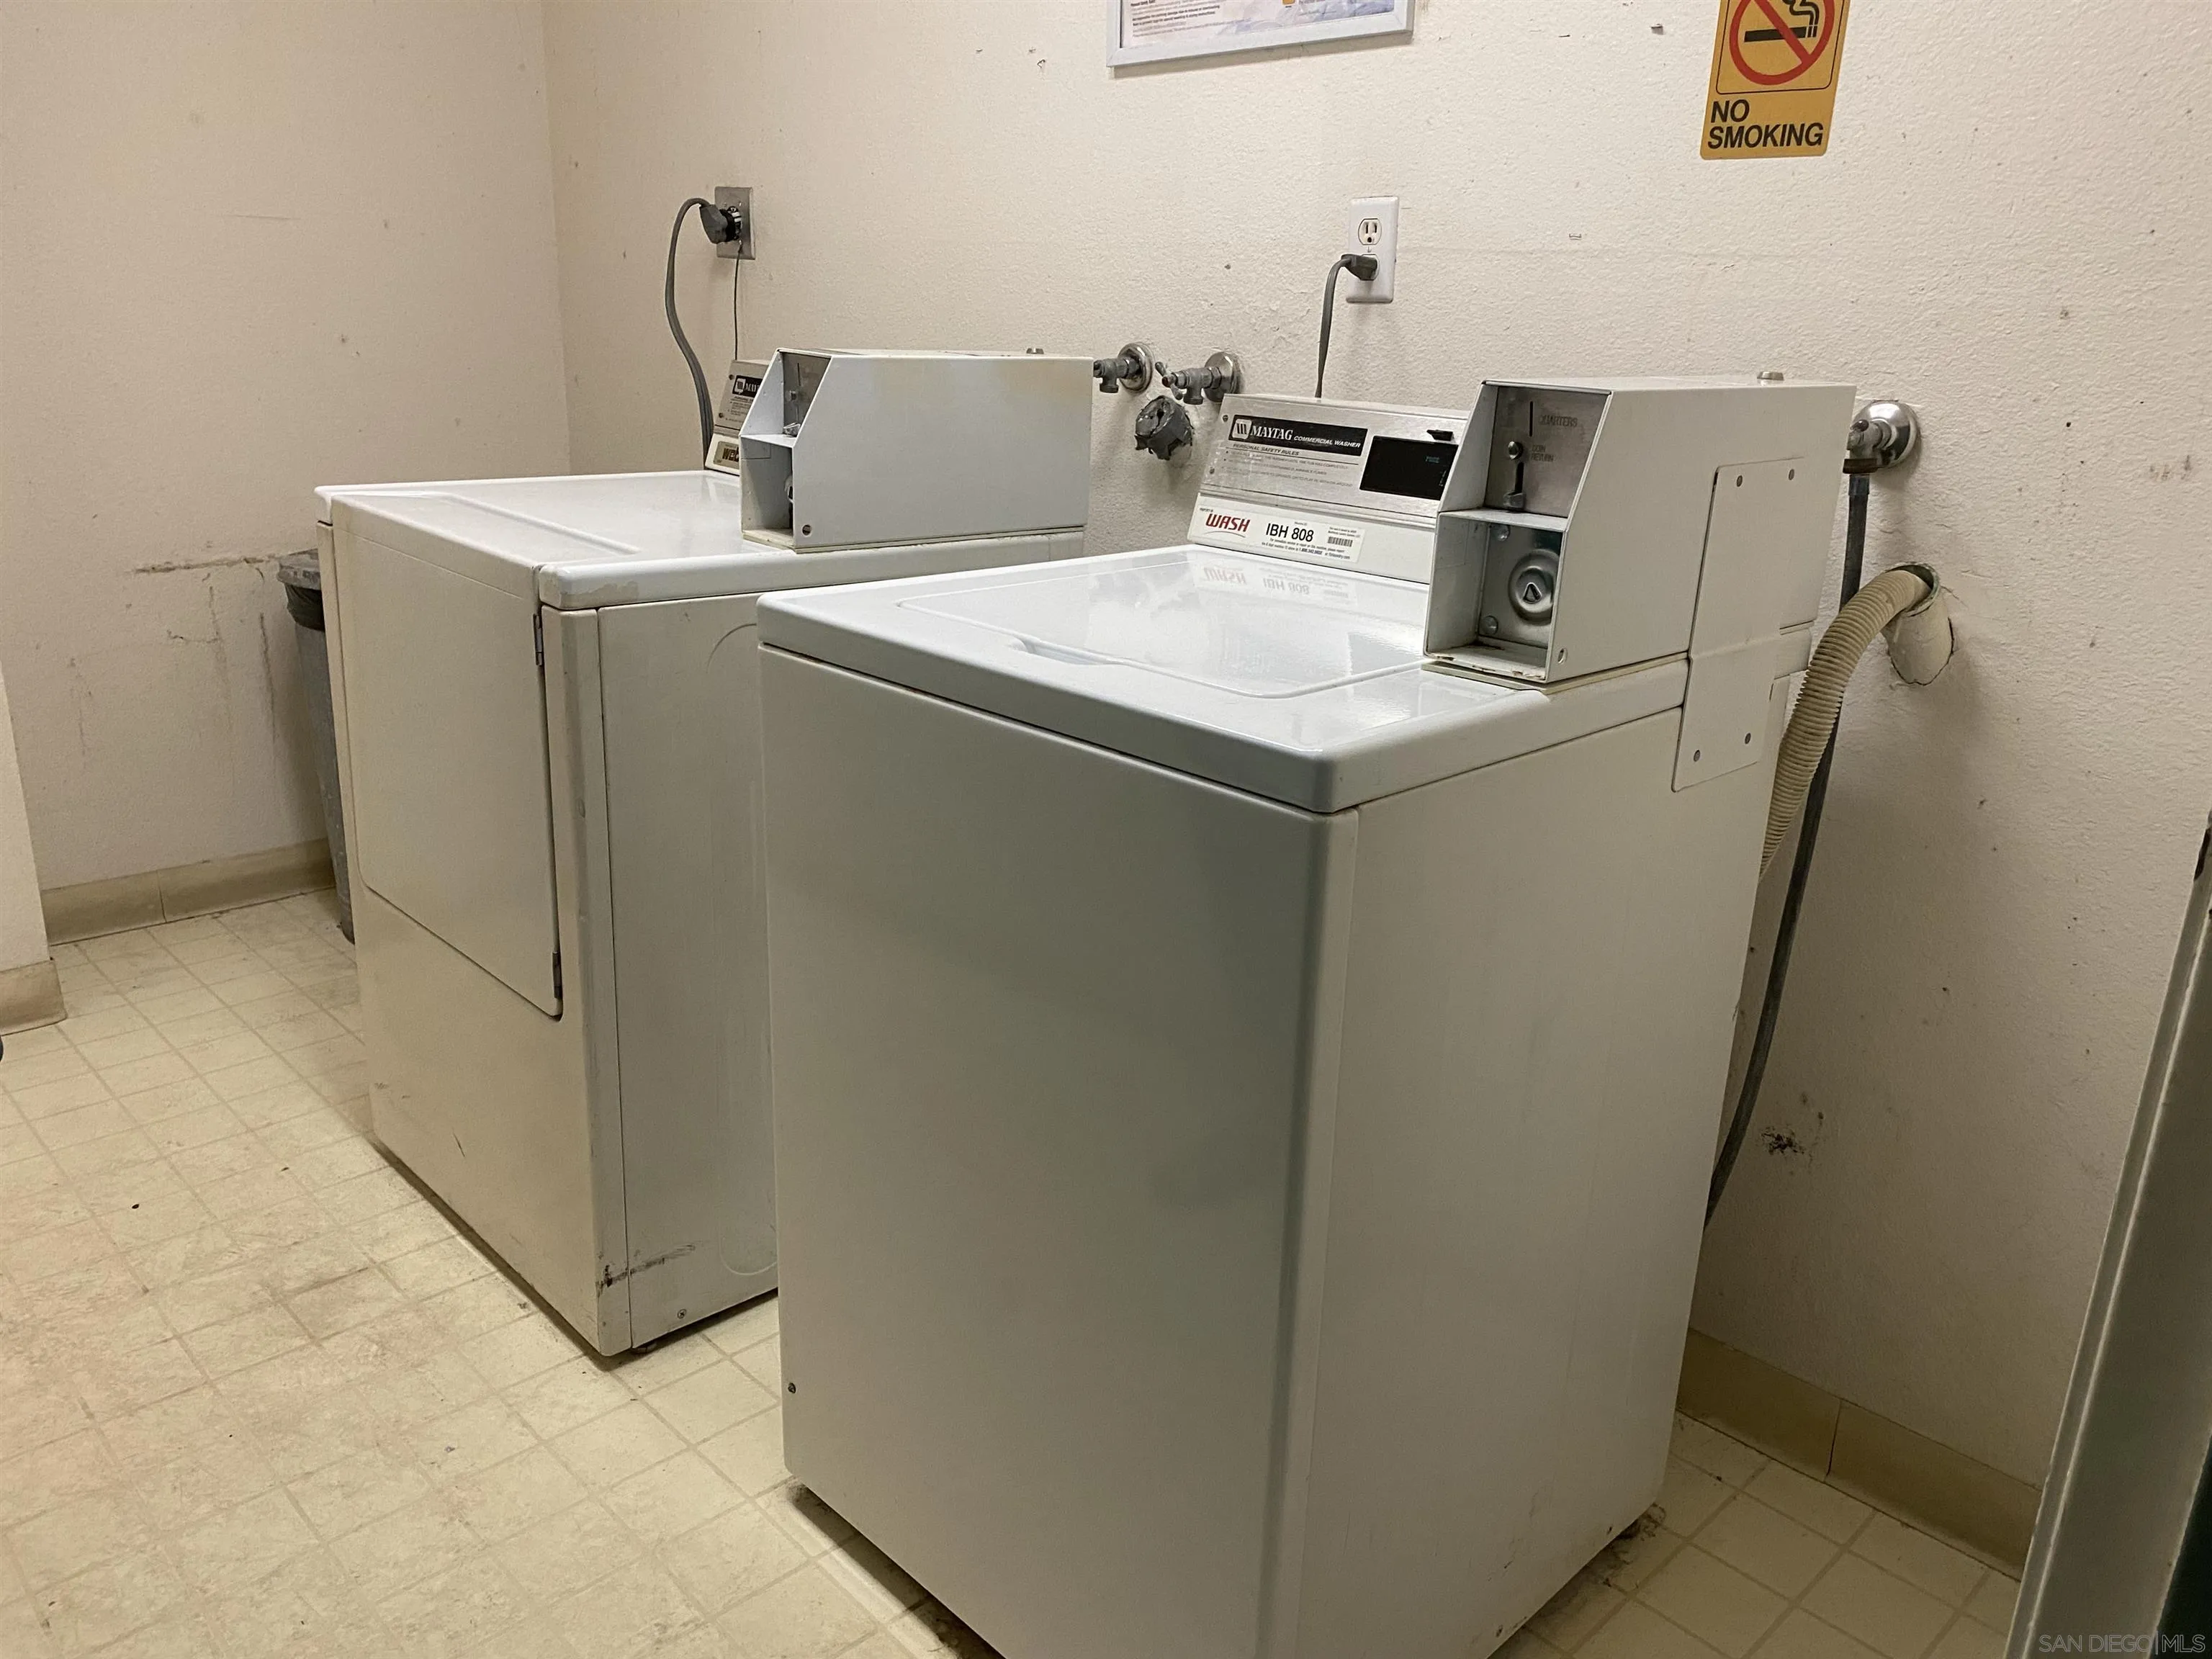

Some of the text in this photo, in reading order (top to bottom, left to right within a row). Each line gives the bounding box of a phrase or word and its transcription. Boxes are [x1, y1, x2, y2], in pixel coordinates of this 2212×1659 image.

[1710, 99, 1750, 123] NO
[1707, 122, 1824, 149] SMOKING
[1250, 426, 1293, 441] MAYTAG
[1294, 435, 1333, 446] COMMERCIAL
[1205, 513, 1250, 531] WASH
[1266, 523, 1289, 539] IBH
[1291, 527, 1314, 542] 808
